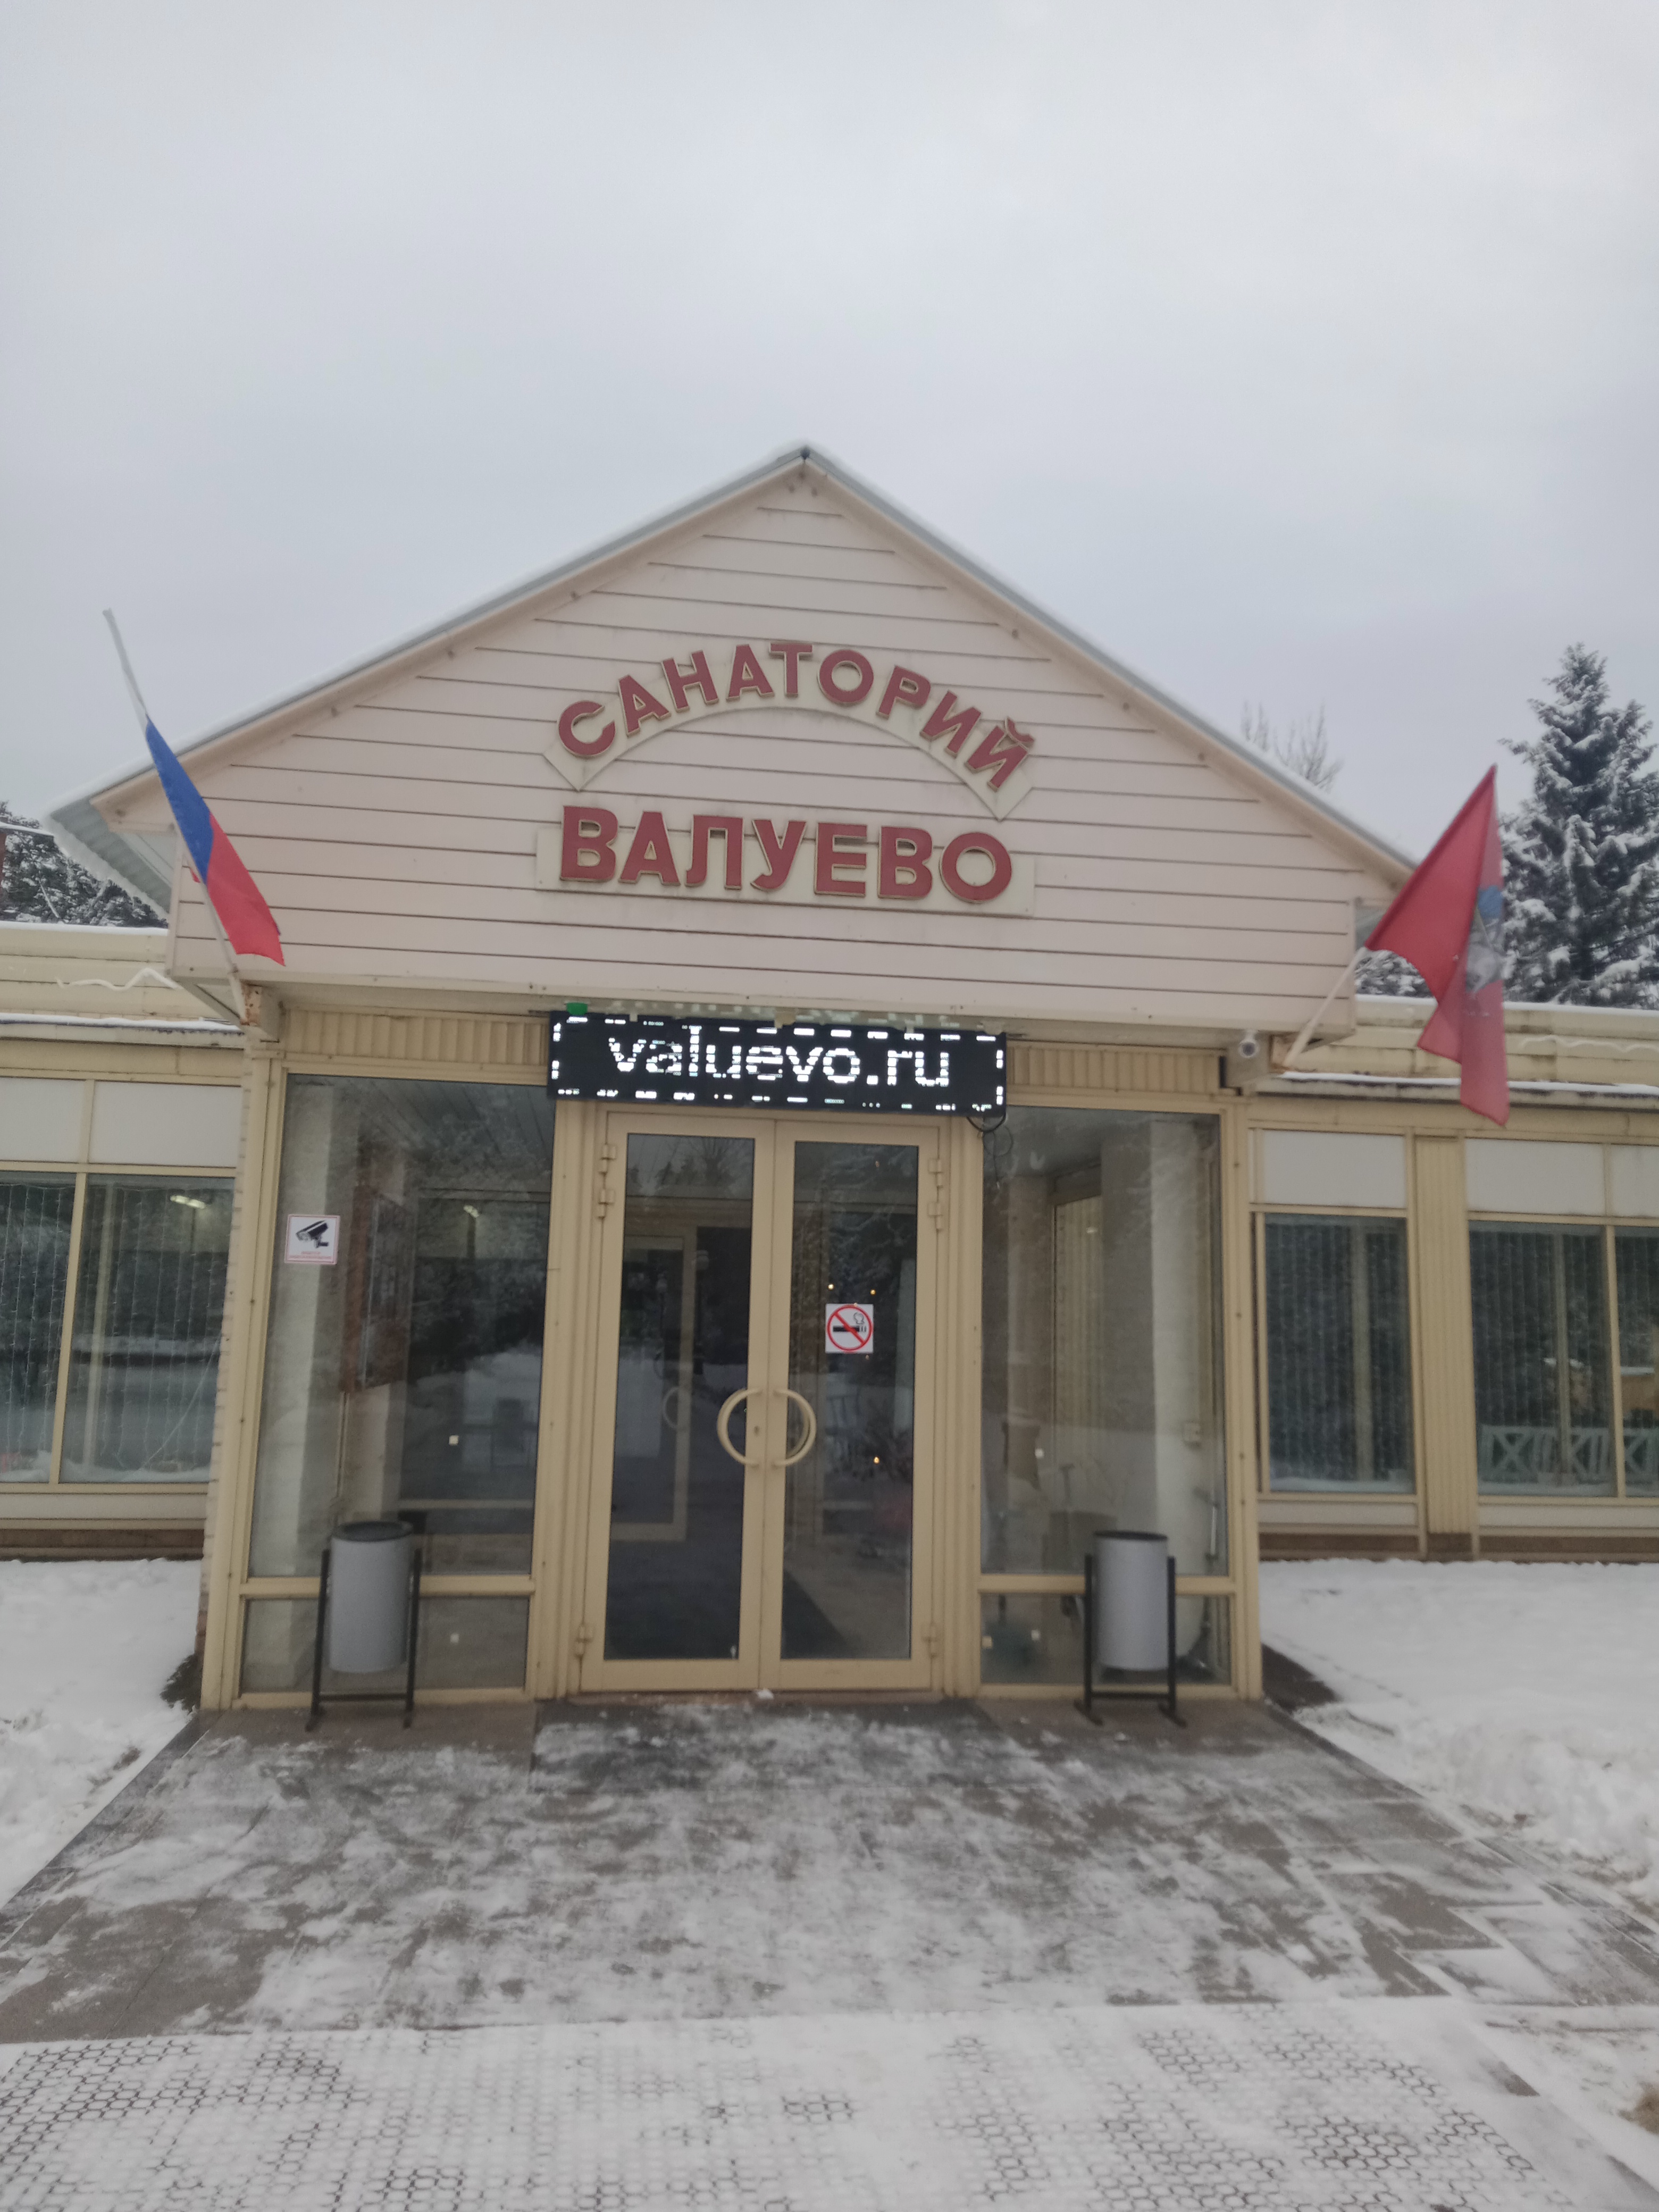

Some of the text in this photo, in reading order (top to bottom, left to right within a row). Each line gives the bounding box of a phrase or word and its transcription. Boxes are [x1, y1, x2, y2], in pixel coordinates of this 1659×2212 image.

[558, 642, 1035, 791] САНАТОРИЙ
[559, 806, 1012, 903] ВАЛУЕВО
[609, 1026, 949, 1086] valuevo.ru
